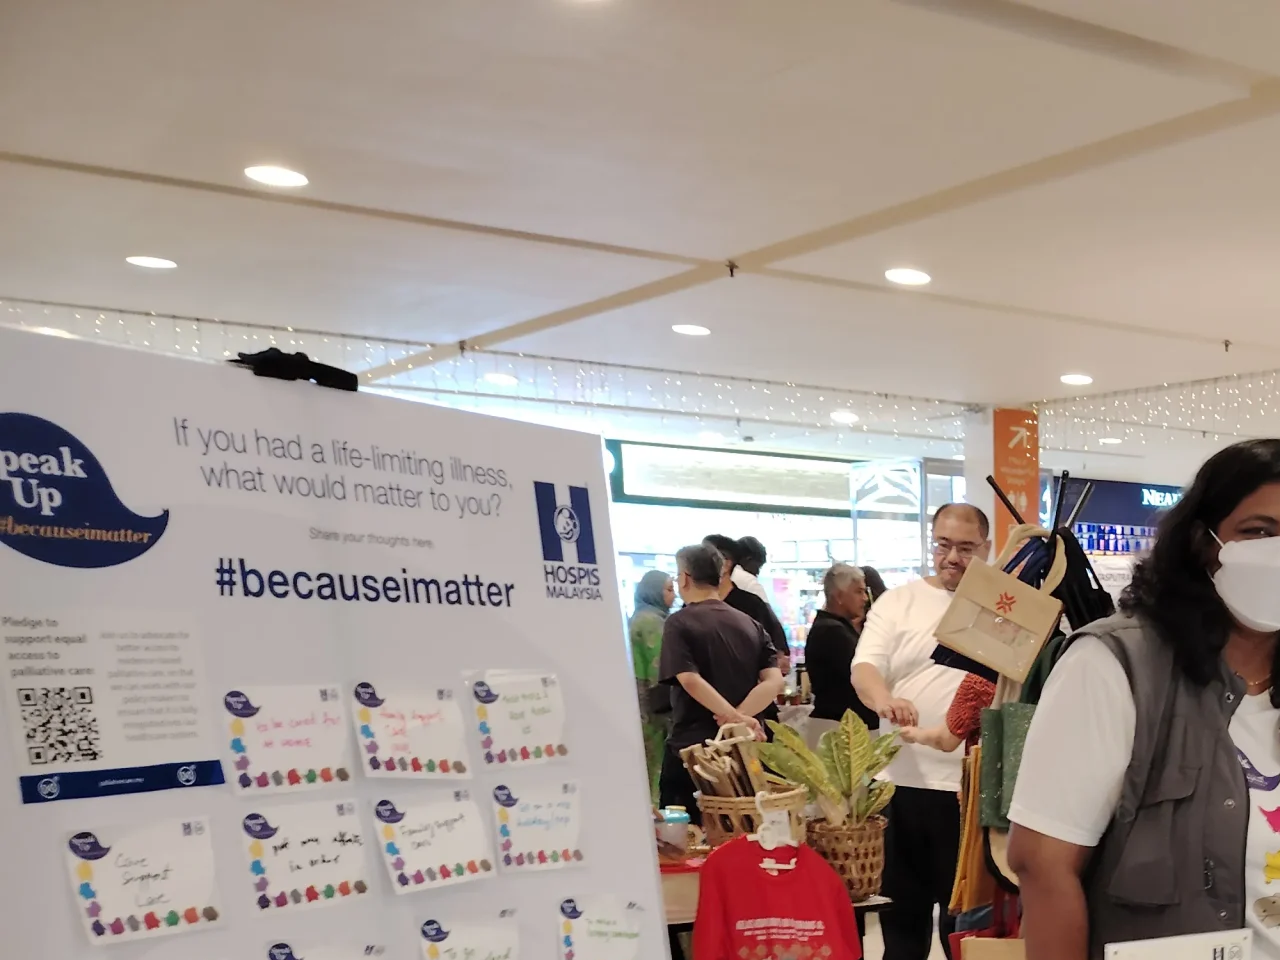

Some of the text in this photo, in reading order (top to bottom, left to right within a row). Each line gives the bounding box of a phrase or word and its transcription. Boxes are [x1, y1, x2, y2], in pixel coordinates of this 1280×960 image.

[174, 417, 189, 447] If
[197, 427, 247, 456] you
[254, 429, 303, 460] had
[311, 443, 327, 463] a
[332, 439, 444, 485] life-limiting
[0, 446, 88, 481] peak
[11, 477, 62, 516] Up
[200, 461, 502, 519] what would matter to you?
[309, 527, 340, 542] Share
[342, 533, 365, 545] your
[367, 533, 410, 548] thoughts
[215, 557, 515, 608] #becauseimatter
[544, 564, 600, 586] HOSPIS
[546, 585, 603, 601] MALAYSIA
[2, 616, 42, 629] Pledge
[4, 634, 87, 645] support equal
[9, 651, 44, 661] access
[11, 666, 64, 678] palliative
